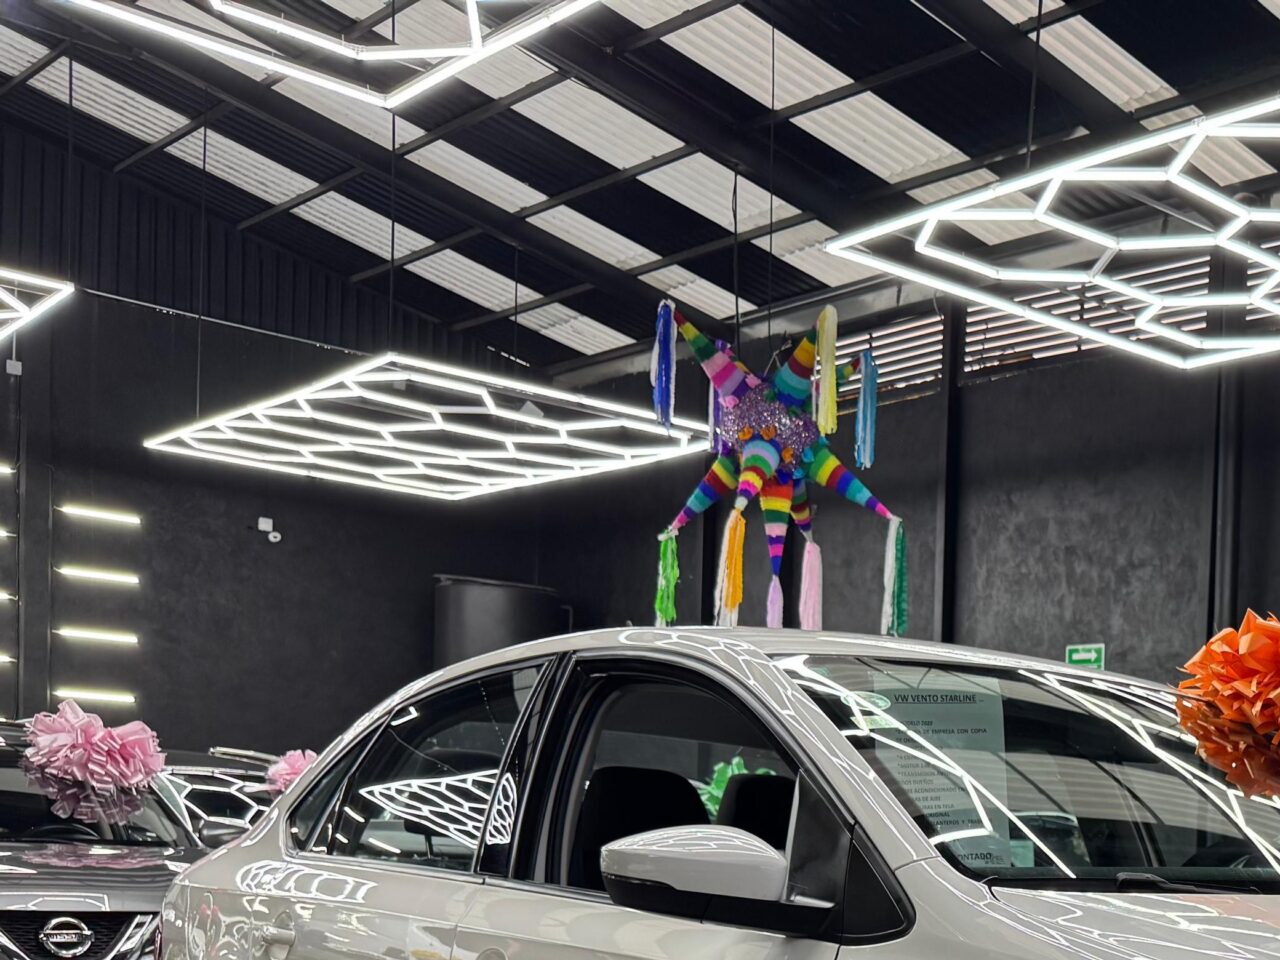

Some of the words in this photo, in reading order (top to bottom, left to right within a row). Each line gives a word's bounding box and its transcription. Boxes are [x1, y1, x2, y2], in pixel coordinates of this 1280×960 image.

[894, 694, 909, 702] VW
[911, 694, 939, 702] VENTO
[940, 694, 977, 702] STARLINE
